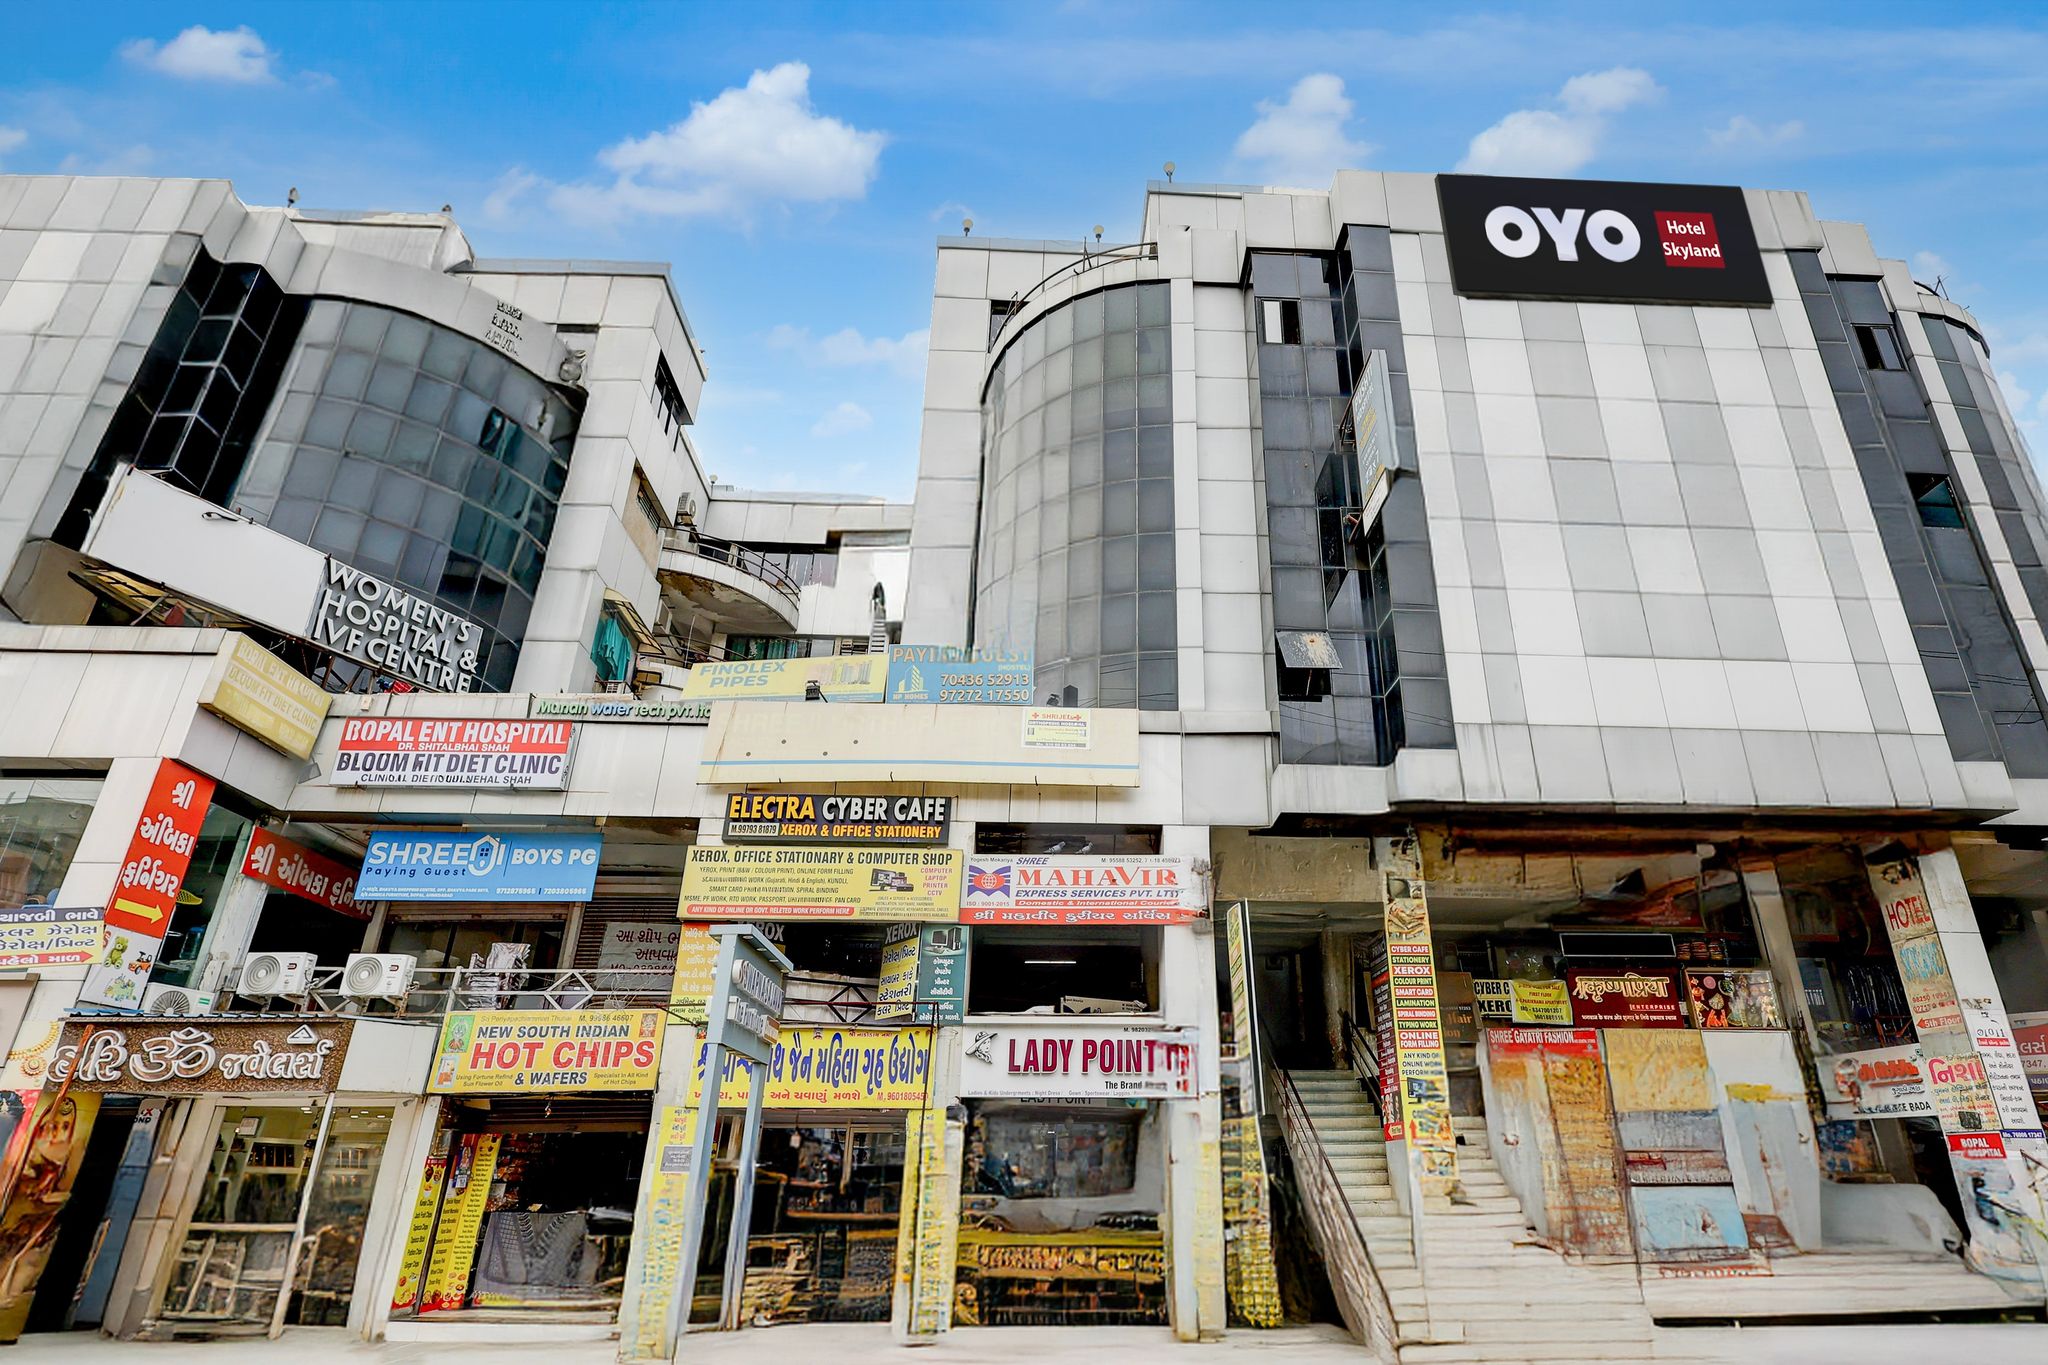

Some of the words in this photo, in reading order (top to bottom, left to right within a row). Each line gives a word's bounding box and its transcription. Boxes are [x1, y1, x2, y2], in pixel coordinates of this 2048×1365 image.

[1485, 205, 1641, 262] OYO
[1666, 220, 1706, 236] Hotel
[1662, 242, 1721, 259] Skyland
[322, 588, 454, 664] HOSPITAL
[458, 648, 479, 675] &
[313, 607, 365, 652] IVF
[366, 638, 473, 694] CENTRE
[700, 661, 787, 676] FINOLEX
[709, 675, 769, 689] PIPES
[941, 674, 983, 687] 70436
[987, 673, 1030, 687] 52913
[939, 690, 983, 702] 97272
[987, 690, 1030, 702] 17550
[591, 702, 633, 716] water
[635, 703, 665, 717] tech
[418, 721, 462, 743] ENT
[463, 721, 567, 745] HOSPITAL
[397, 742, 415, 751] DR.
[418, 742, 480, 752] SHITALBHAI
[481, 743, 511, 752] SHAH
[446, 754, 493, 774] DIET
[493, 754, 562, 775] CLINIC
[502, 775, 532, 785] SHAH
[171, 779, 196, 810] શ્રી
[729, 795, 816, 821] ELECTRA
[822, 797, 888, 822] CYBER
[893, 798, 946, 822] CAFE
[139, 812, 195, 858] અંબિકા
[780, 823, 818, 837] XEROX
[820, 824, 829, 837] &
[832, 824, 873, 838] OFFICE
[874, 825, 942, 838] STATIONERY
[511, 848, 564, 866] BOYS
[567, 848, 597, 866] PG
[691, 850, 731, 864] XEROX,
[734, 850, 772, 863] OFFICE
[775, 851, 844, 864] STATIONARY
[847, 852, 855, 864] &
[858, 852, 919, 865] COMPUTER
[922, 853, 953, 866] SHOP
[1016, 857, 1050, 865] SHREE
[365, 866, 417, 878] Paying
[424, 866, 467, 877] Guest
[1016, 866, 1179, 886] MAHAVIR
[1015, 889, 1068, 898] EXPRESS
[1071, 889, 1126, 898] SERVICES
[1129, 890, 1153, 898] PVT.
[974, 910, 994, 920] શ્રી
[1002, 910, 1058, 920] મહાવીર
[1885, 894, 1932, 932] HOTEL
[637, 928, 662, 944] શોપ
[885, 922, 918, 945] XEROX
[1391, 945, 1412, 953] CYBER
[1392, 956, 1430, 964] STATIONERY
[1393, 966, 1431, 974] XEROX
[1395, 988, 1416, 996] SMART
[1416, 988, 1433, 996] CARD
[1473, 981, 1502, 996] CYBER
[1396, 999, 1435, 1007] LAMINATION
[1399, 1021, 1420, 1029] TYPING
[1924, 1018, 1939, 1029] 5th
[1939, 1016, 1963, 1028] Floor
[477, 1026, 513, 1039] NEW
[517, 1025, 571, 1038] SOUTH
[575, 1025, 630, 1038] INDIAN
[1400, 1031, 1439, 1040] ONLINE
[1490, 1031, 1513, 1043] SHREE
[1514, 1031, 1544, 1044] GAYATRI
[1544, 1032, 1574, 1044] FASHION
[1400, 1040, 1418, 1048] FORM
[1418, 1040, 1440, 1048] FILLING
[46, 1028, 127, 1083] હરિ
[470, 1041, 544, 1070] HOT
[552, 1040, 656, 1069] CHIPS
[816, 1032, 857, 1089] મહિલા
[1008, 1039, 1074, 1074] LADY
[1082, 1038, 1157, 1075] POINT
[514, 1072, 525, 1086] &
[530, 1071, 589, 1086] WAFERS
[1928, 1058, 1986, 1085] નિશા
[1105, 1081, 1119, 1090] The
[1120, 1080, 1143, 1090] Brand
[769, 1088, 791, 1101] અને
[793, 1088, 828, 1103] ચવાણું
[833, 1088, 861, 1101] મળશે
[1908, 1101, 1932, 1112] BADA
[1960, 1138, 1990, 1148] BOPAL
